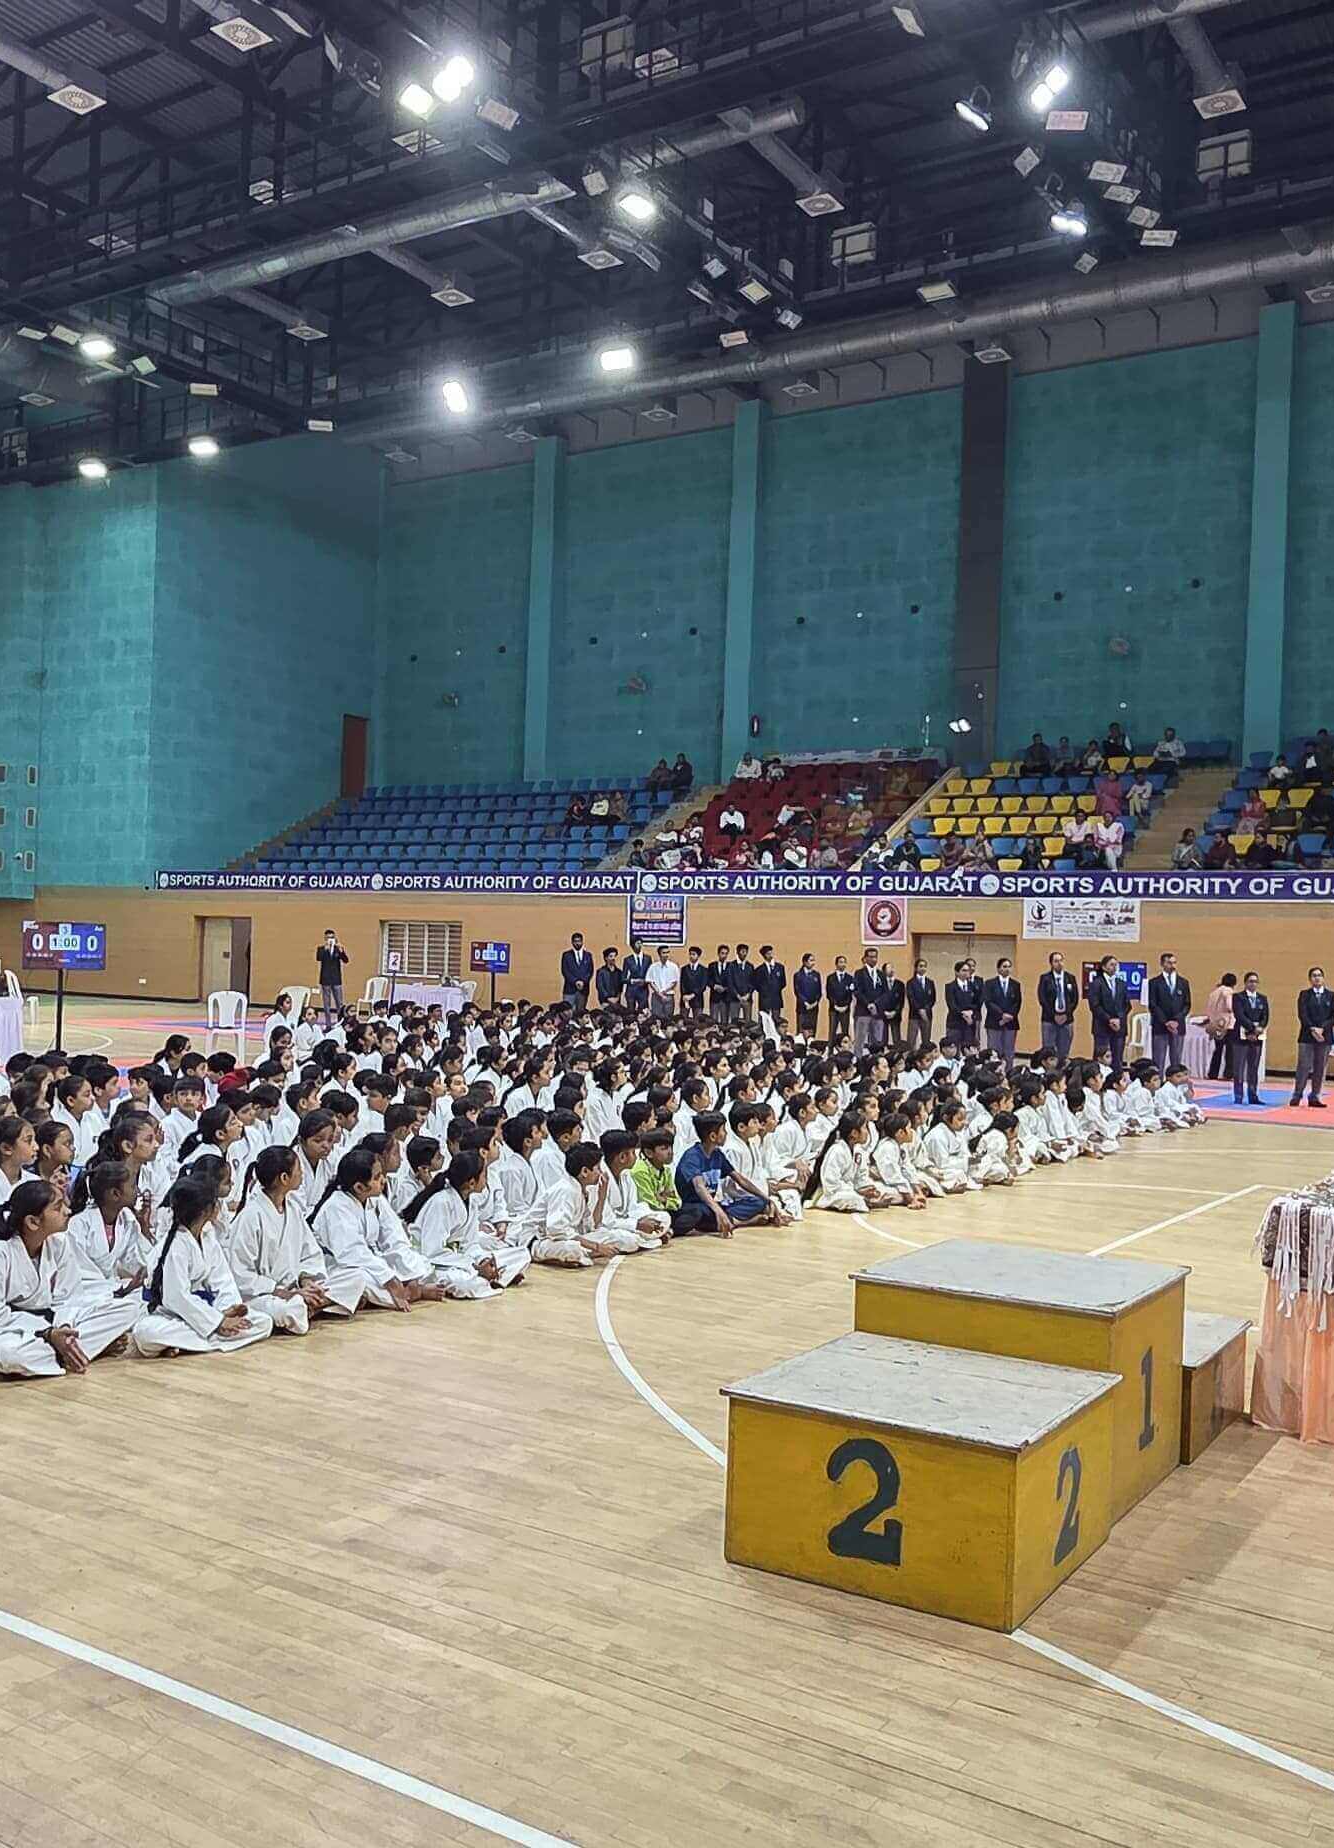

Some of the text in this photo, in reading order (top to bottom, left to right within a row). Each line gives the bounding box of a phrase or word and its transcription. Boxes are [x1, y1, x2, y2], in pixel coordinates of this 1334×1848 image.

[169, 874, 370, 889] SPORTS AUTHORITY OF GUJARAT
[384, 875, 635, 890] SPORTS AUTHORITY OF GUJARAT
[657, 875, 977, 893] SPORTS AUTHORITY OF GUJARAT
[1001, 877, 1094, 894] SPORTS
[1099, 877, 1242, 896] AUTHORITY
[1248, 878, 1284, 896] OF
[32, 933, 44, 951] 0
[87, 935, 98, 952] 0
[1131, 970, 1142, 986] 0
[1138, 1346, 1155, 1451] 1
[826, 1437, 903, 1567] 2
[1053, 1446, 1082, 1567] 2
